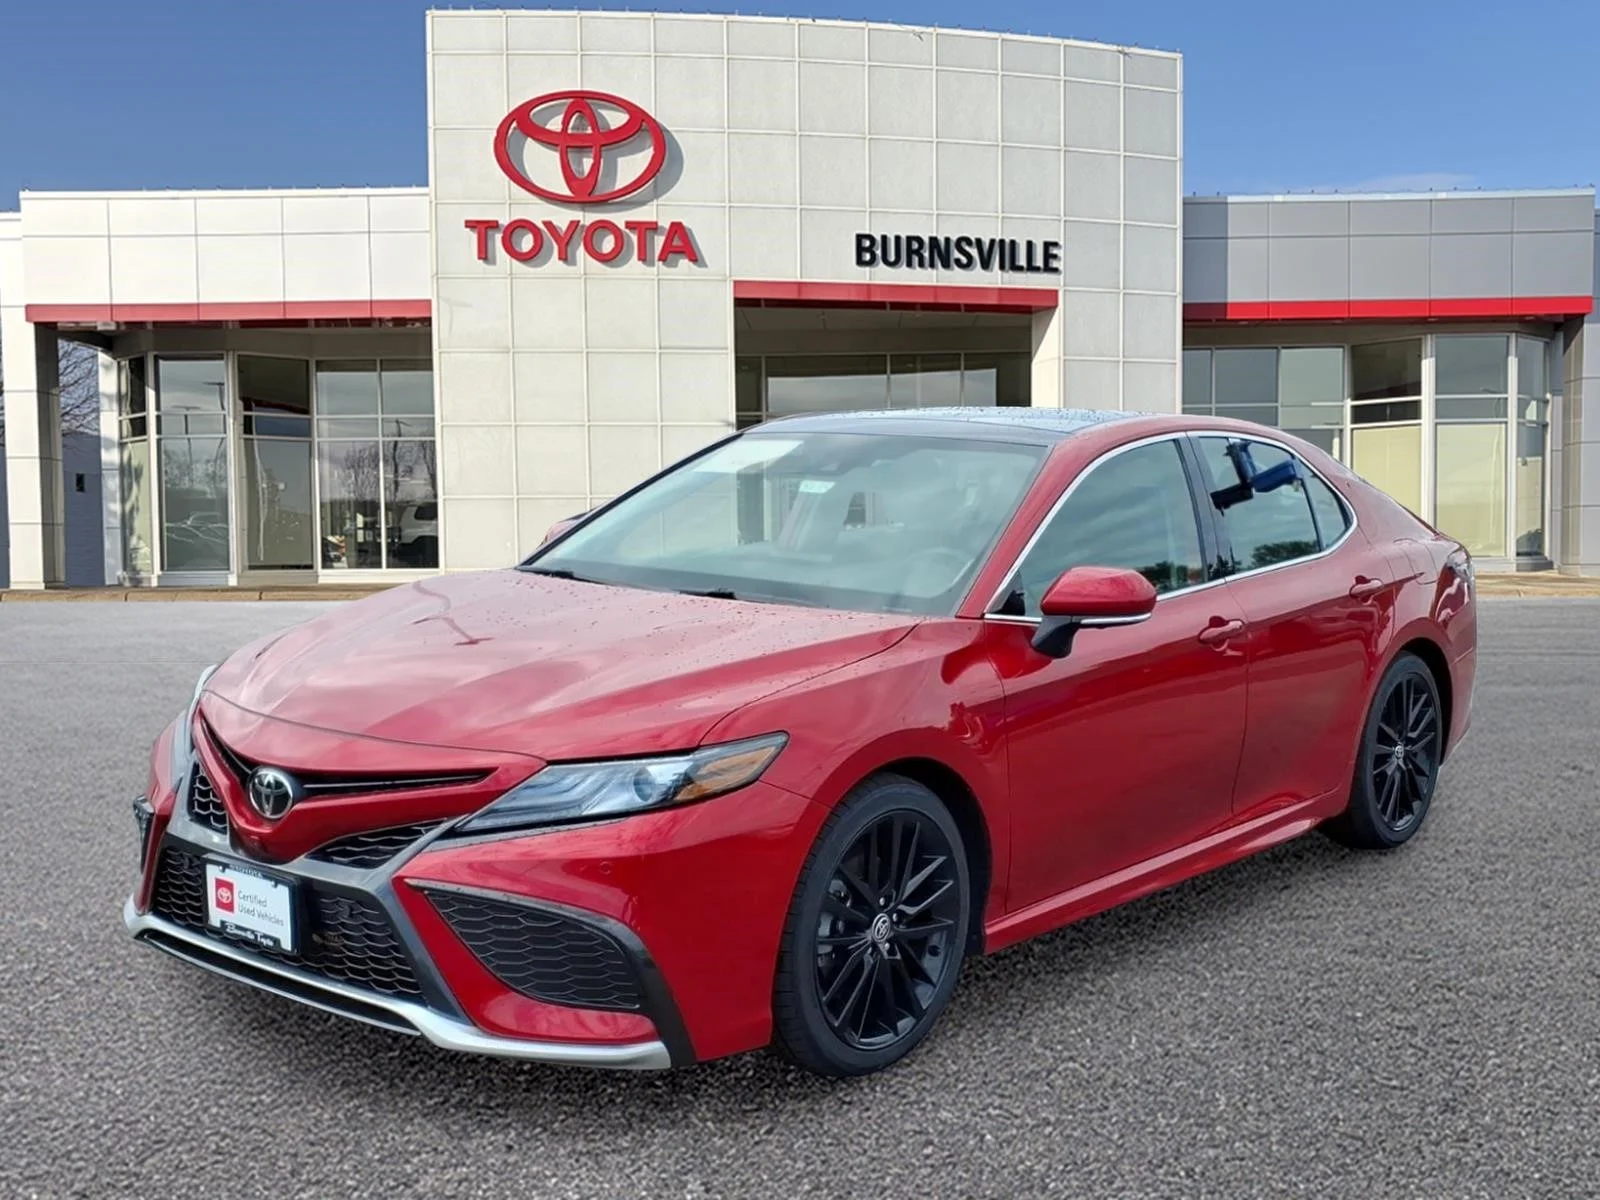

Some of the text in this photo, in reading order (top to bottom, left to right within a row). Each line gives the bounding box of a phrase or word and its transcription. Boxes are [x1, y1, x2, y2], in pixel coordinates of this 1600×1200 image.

[464, 218, 698, 263] TOYOTA
[855, 233, 1061, 273] BURNSVILLE
[238, 889, 267, 907] Certified
[238, 903, 284, 926] Used Vehicles
